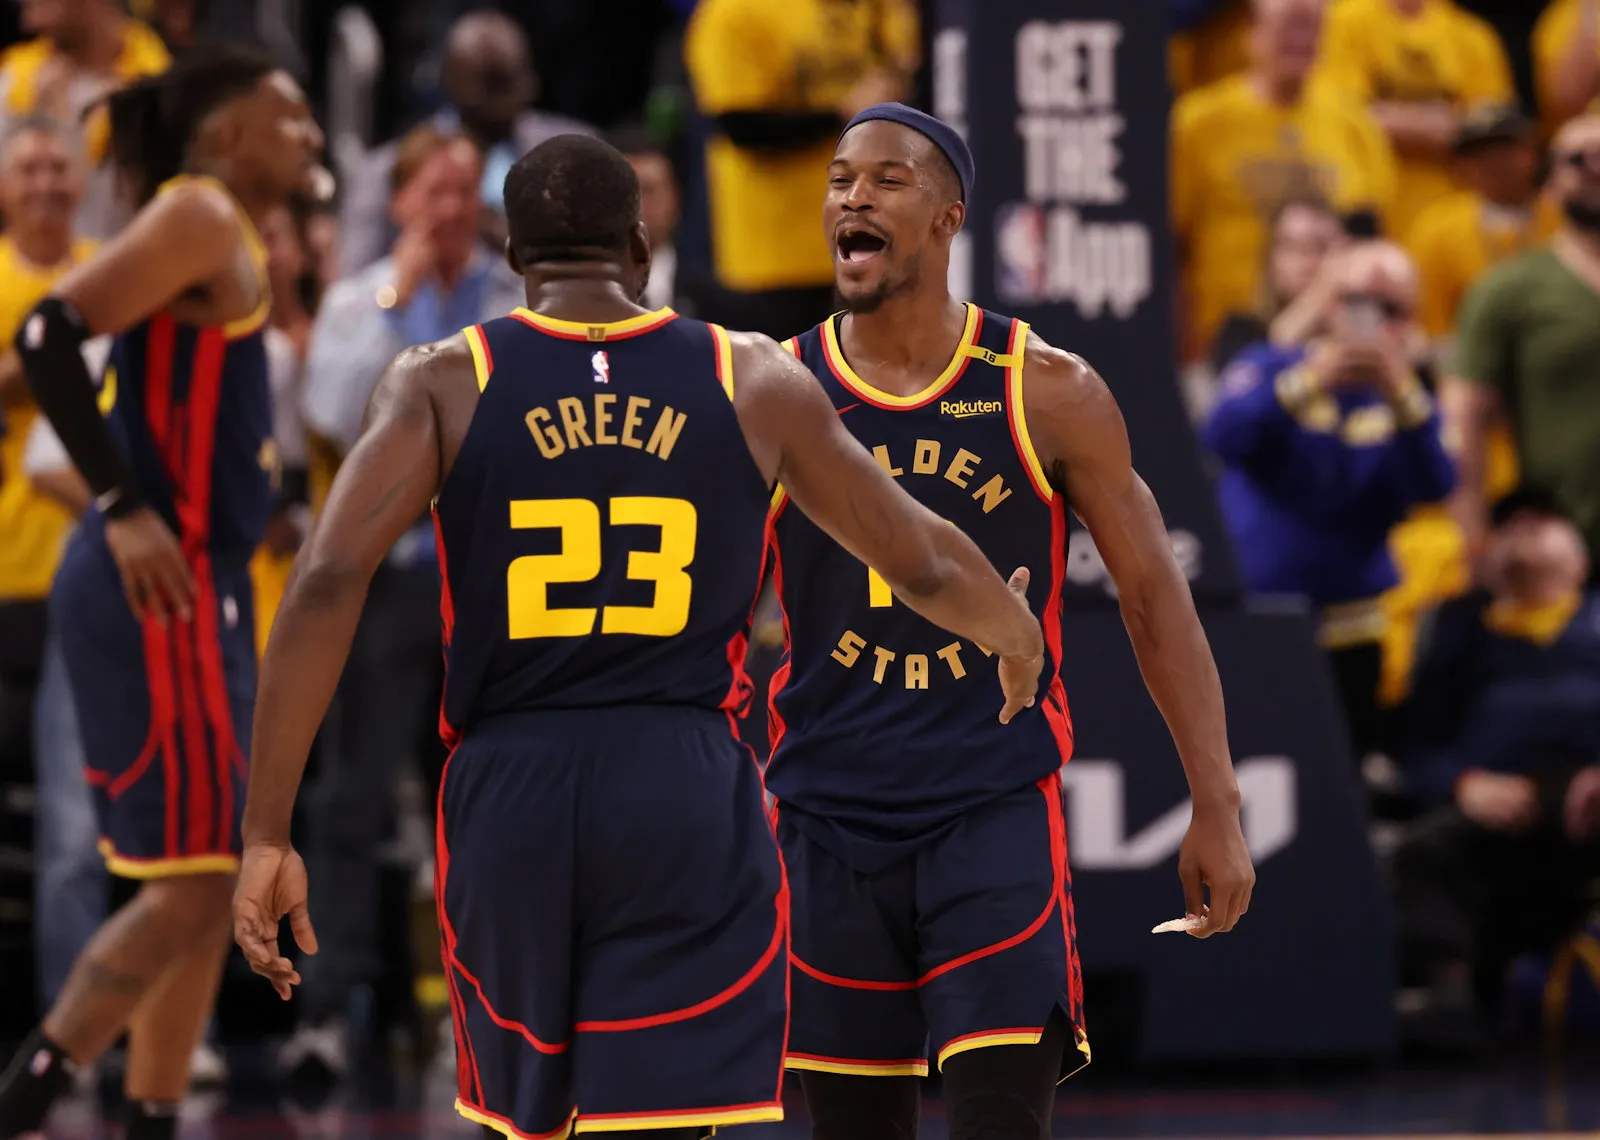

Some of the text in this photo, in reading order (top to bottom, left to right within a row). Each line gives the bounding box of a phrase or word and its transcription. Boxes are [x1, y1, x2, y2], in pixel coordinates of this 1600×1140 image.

[1016, 20, 1122, 108] GET
[1016, 114, 1127, 204] THE
[1047, 207, 1151, 317] App
[982, 350, 997, 363] 16
[524, 393, 688, 461] GREEN
[940, 400, 1002, 419] Rakuten
[872, 438, 1013, 514] LDEN
[507, 496, 698, 640] 23
[830, 629, 993, 690] STAT
